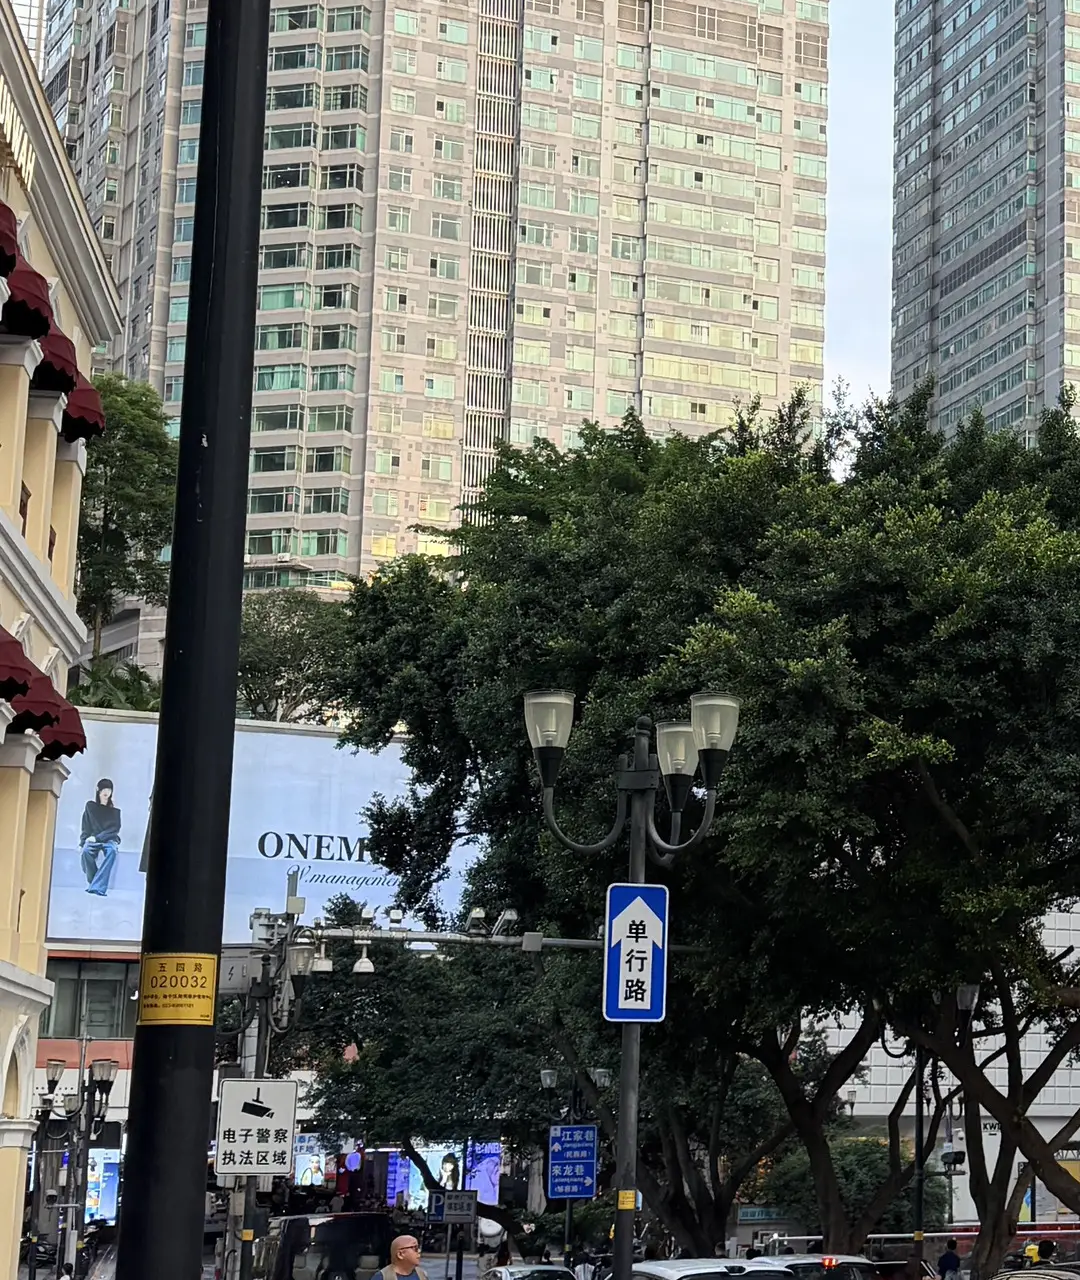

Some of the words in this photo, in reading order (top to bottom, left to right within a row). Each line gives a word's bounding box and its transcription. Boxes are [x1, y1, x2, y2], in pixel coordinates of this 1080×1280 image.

[158, 963, 203, 972] 五四路
[624, 920, 648, 1002] 单行路
[150, 975, 208, 988] 020032
[223, 1128, 288, 1143] 电子警察
[561, 1130, 594, 1141] 江家巷
[221, 1150, 287, 1165] 执法区域
[552, 1165, 584, 1176] 来龙巷
